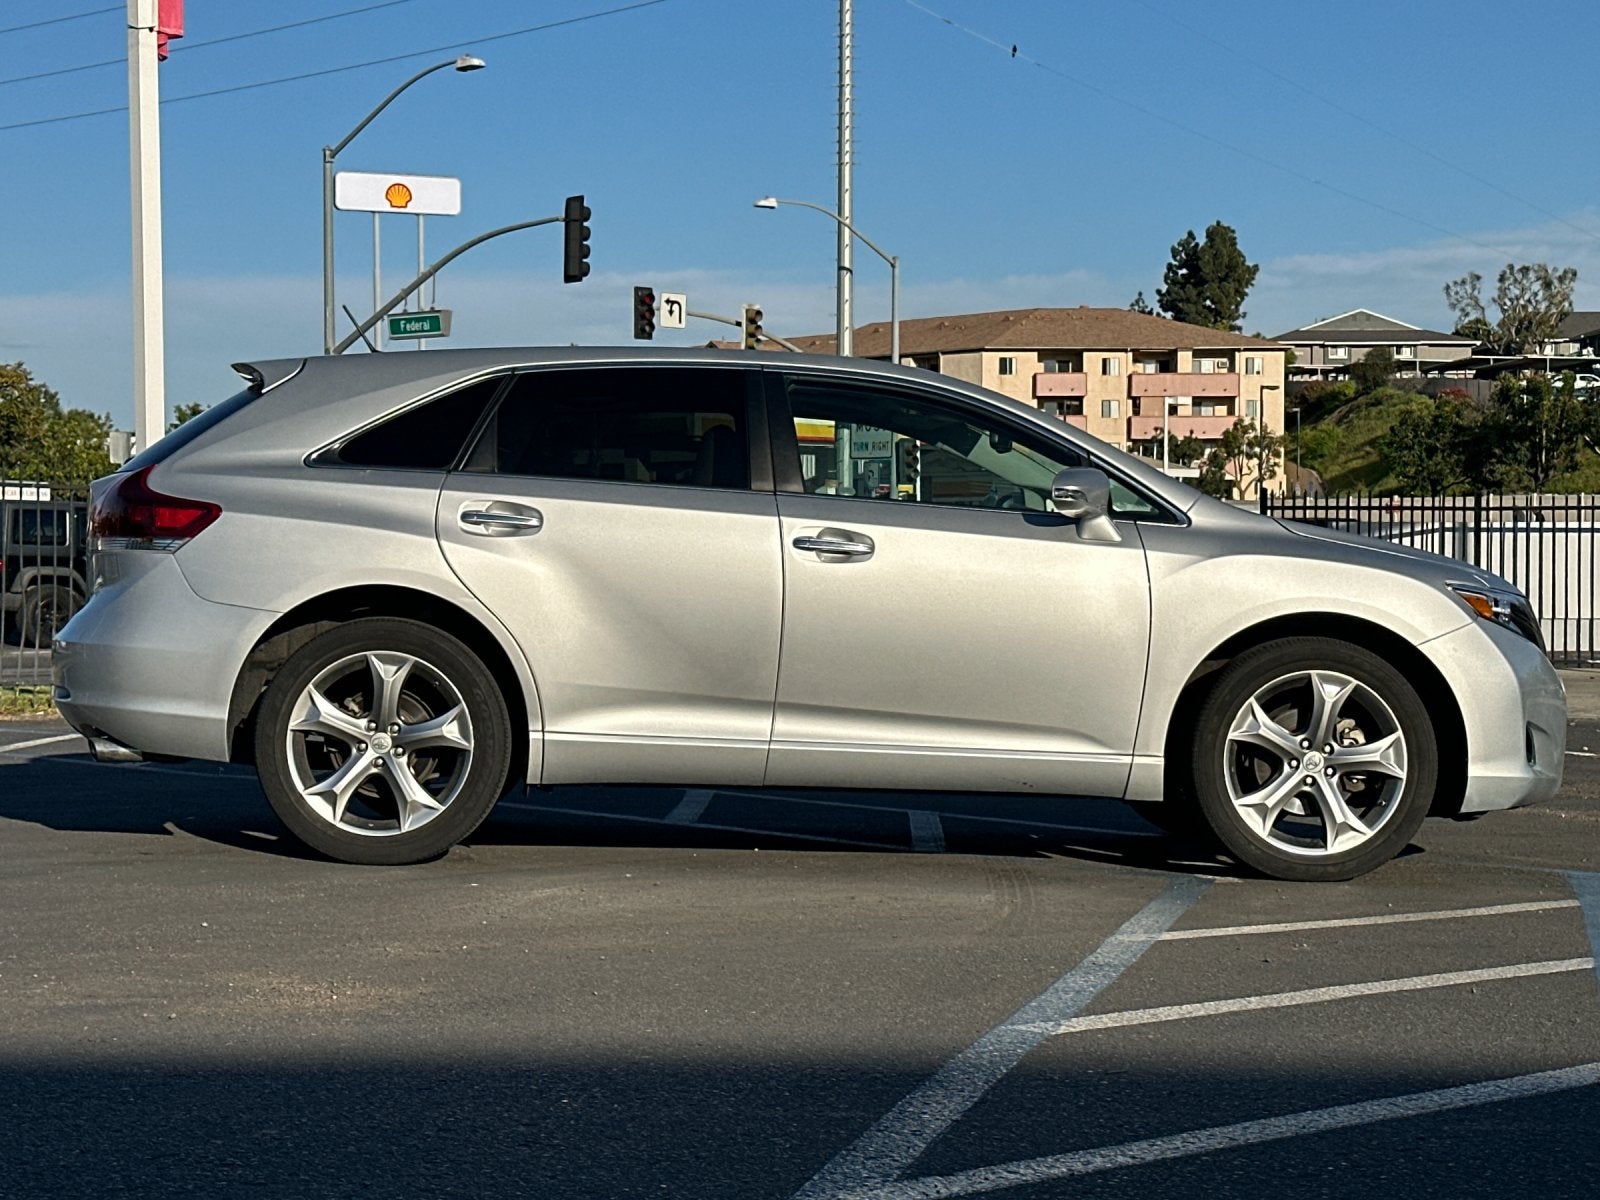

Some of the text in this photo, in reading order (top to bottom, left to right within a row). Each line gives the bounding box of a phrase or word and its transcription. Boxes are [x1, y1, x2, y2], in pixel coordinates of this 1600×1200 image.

[400, 319, 430, 332] Federal
[853, 440, 889, 452] TURN RIGHT
